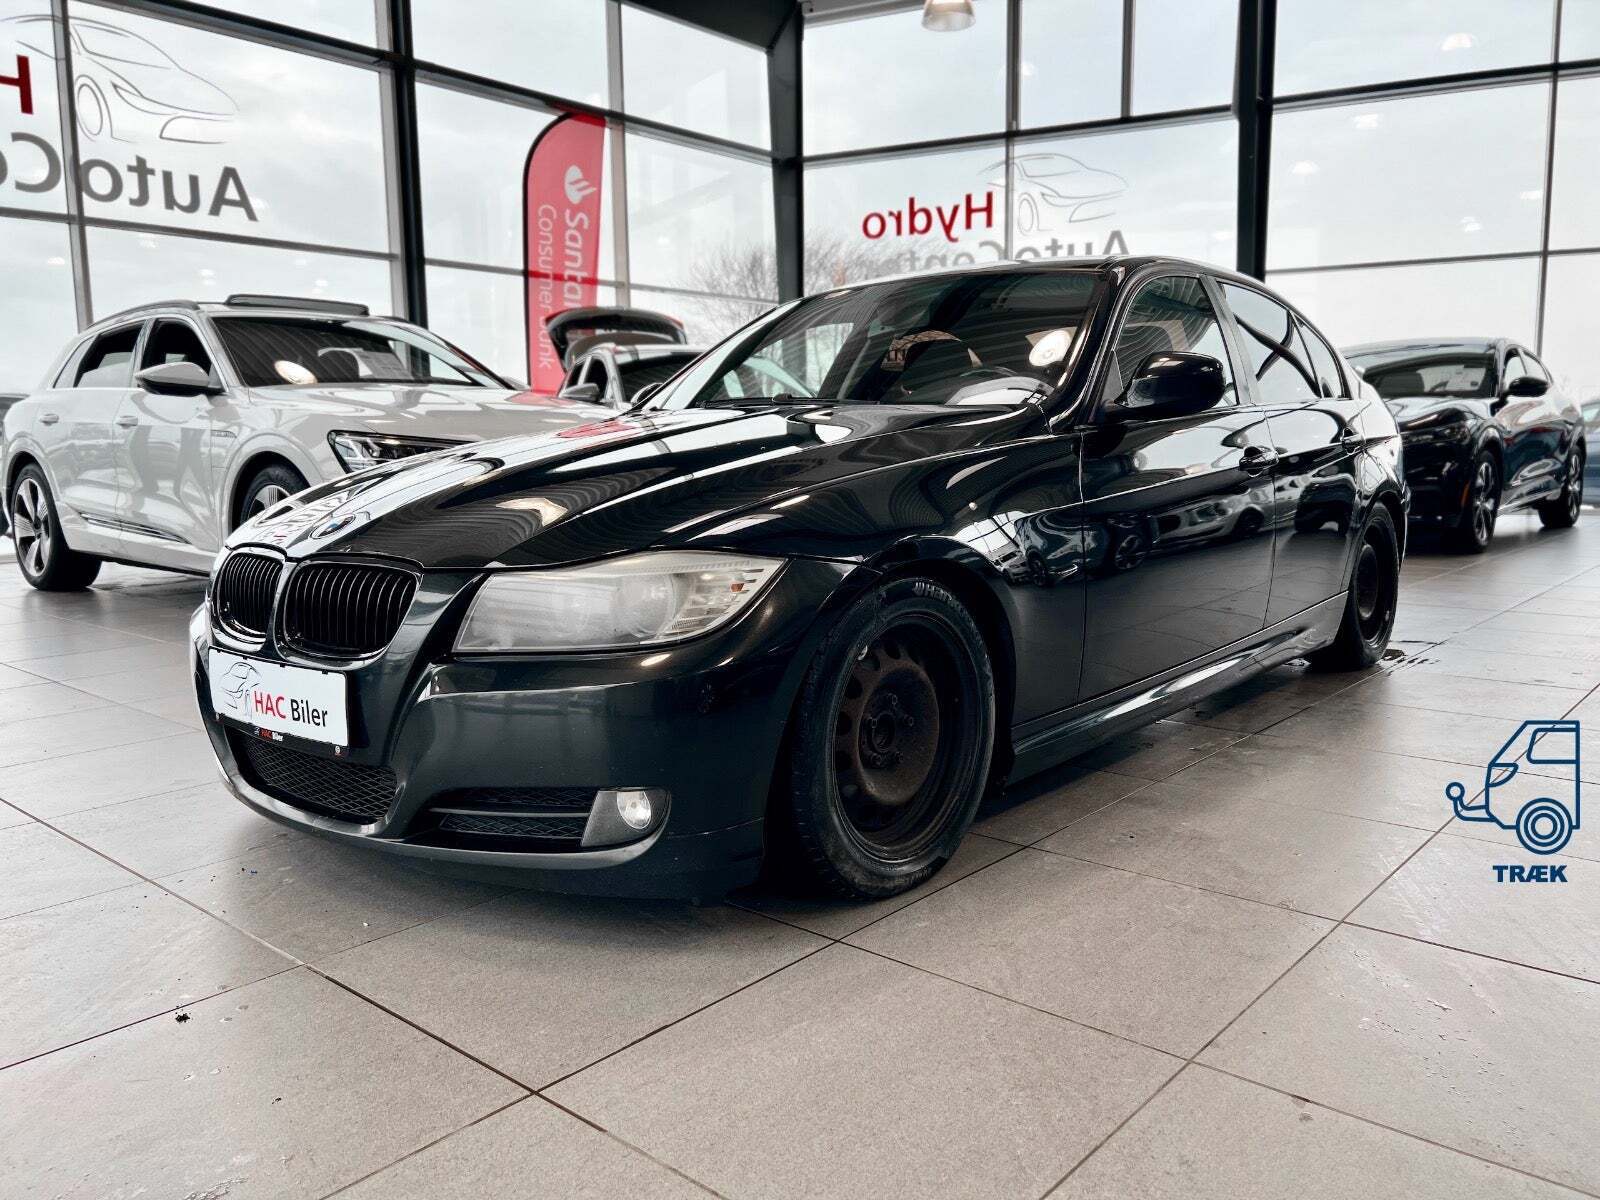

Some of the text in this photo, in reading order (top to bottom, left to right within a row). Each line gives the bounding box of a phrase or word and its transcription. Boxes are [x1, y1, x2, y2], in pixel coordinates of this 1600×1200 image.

[538, 204, 557, 313] Consumer
[254, 690, 328, 727] HAC Biler
